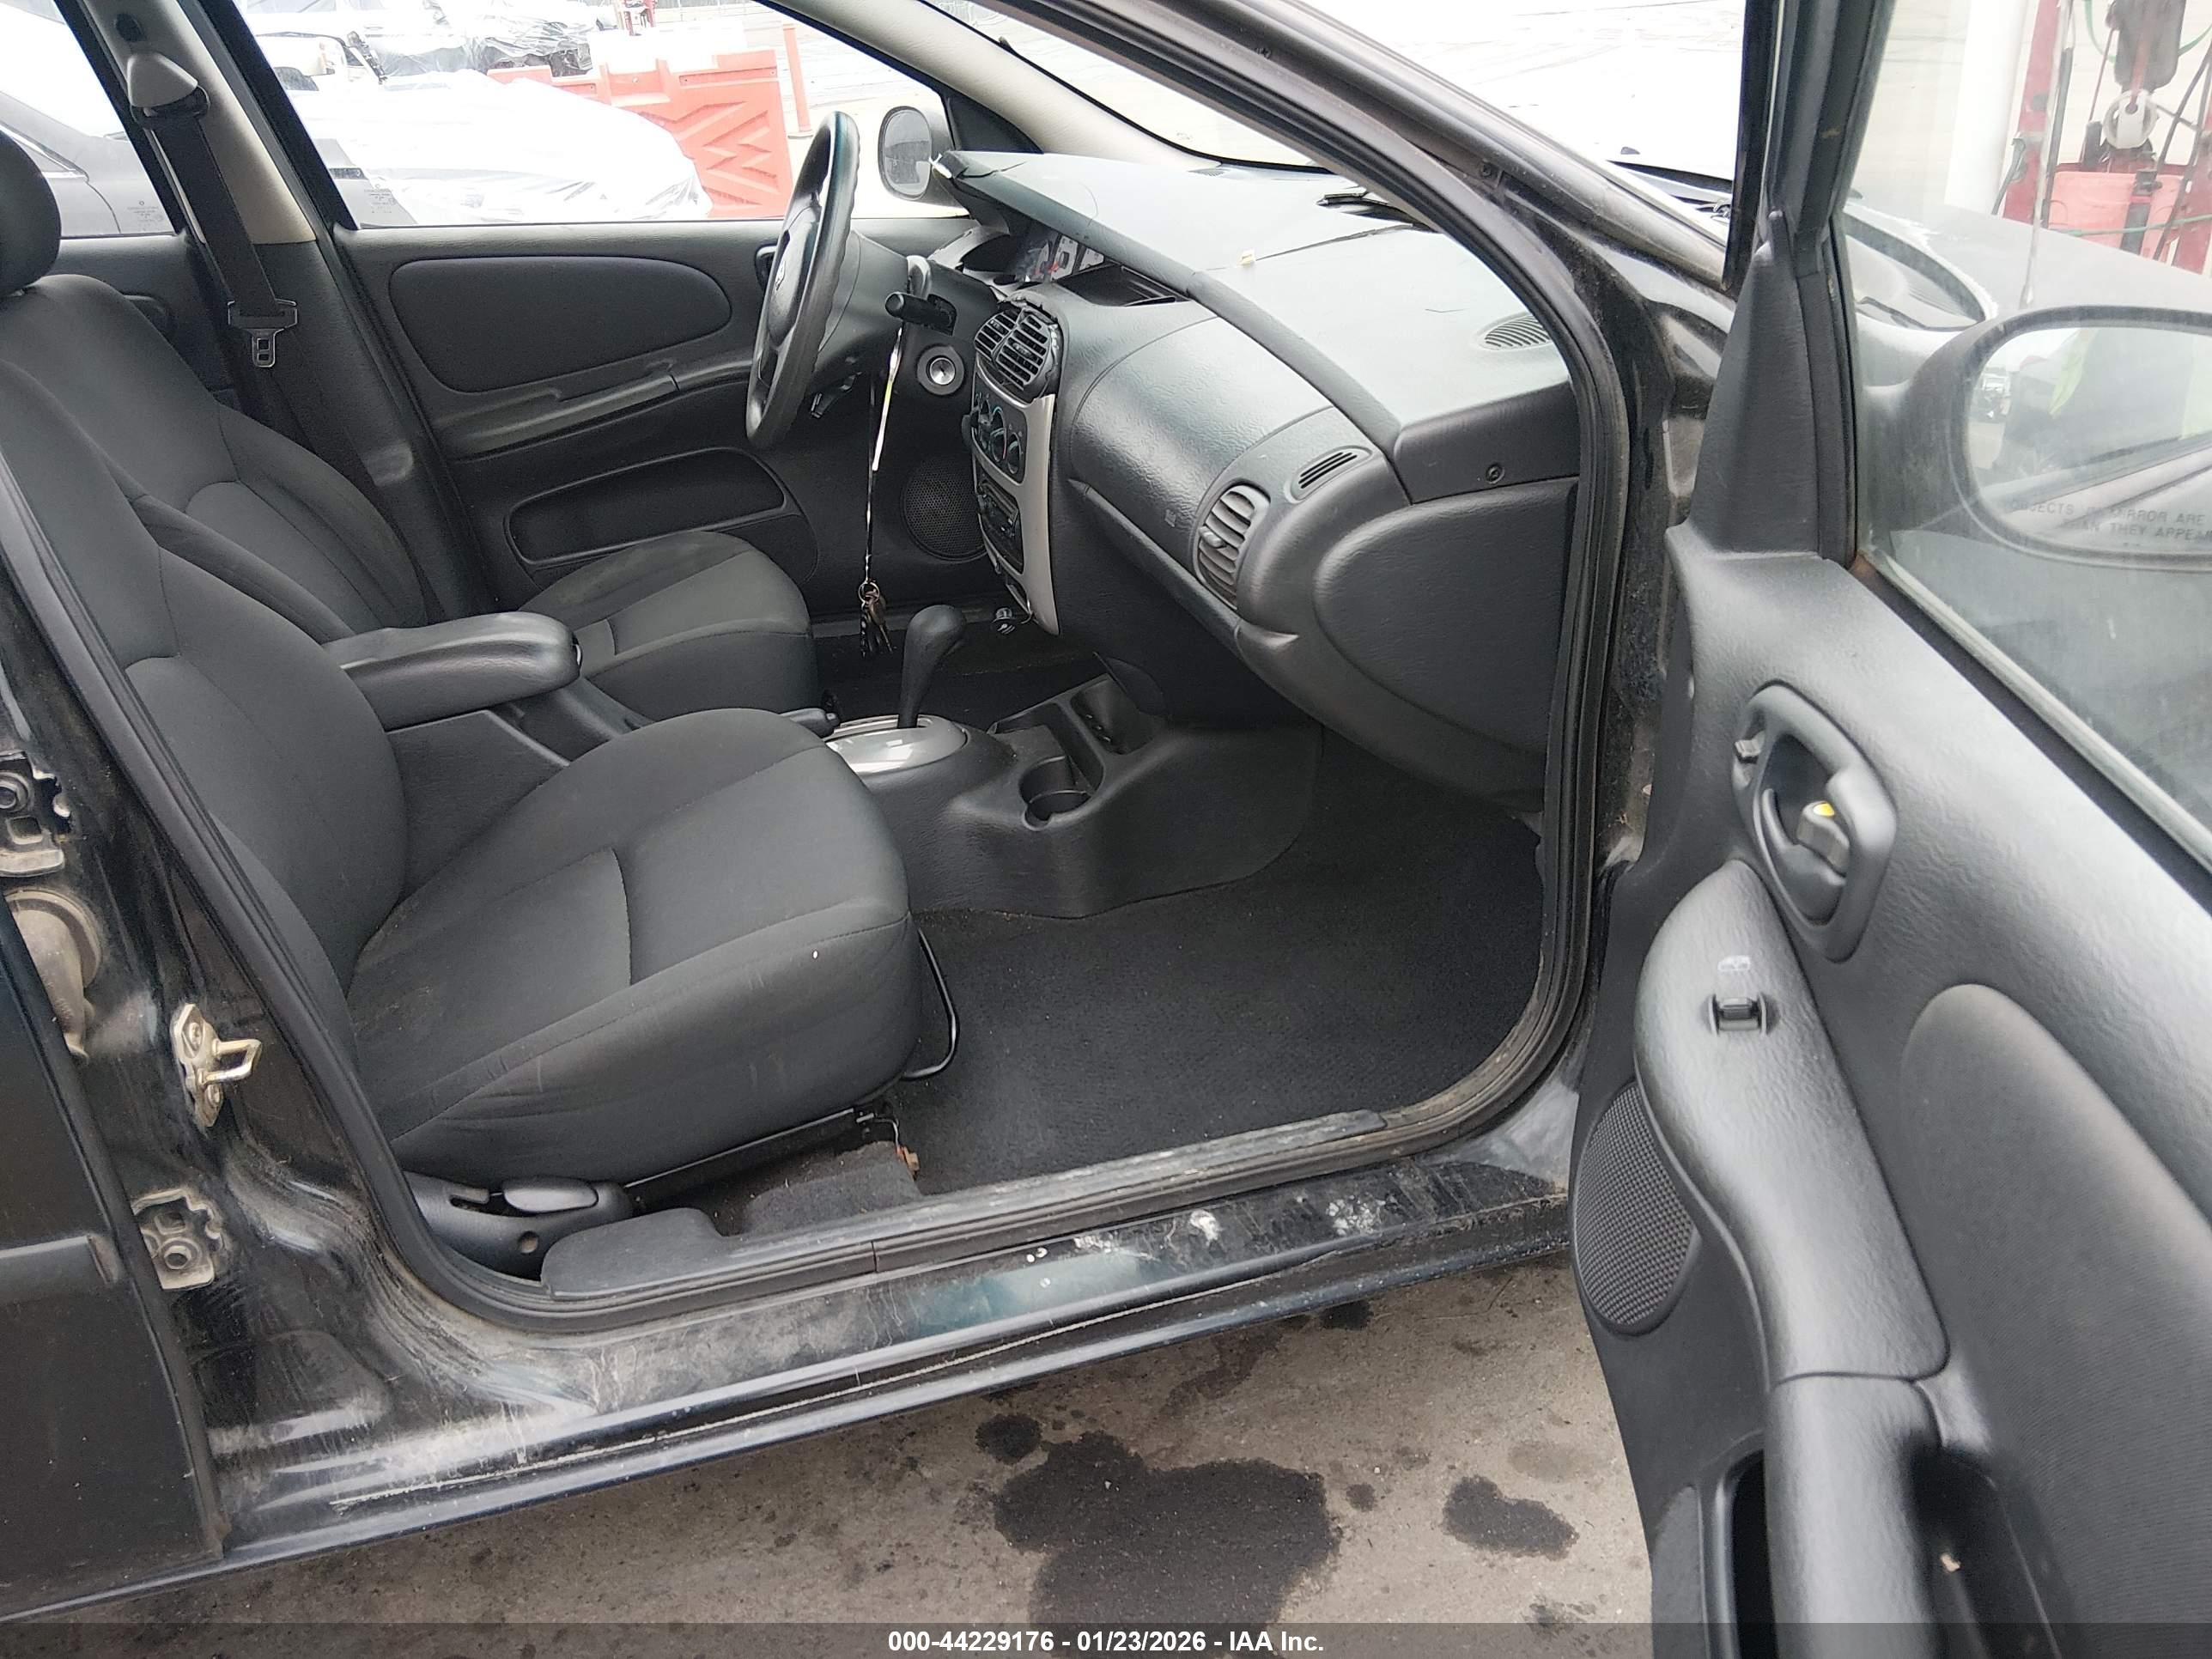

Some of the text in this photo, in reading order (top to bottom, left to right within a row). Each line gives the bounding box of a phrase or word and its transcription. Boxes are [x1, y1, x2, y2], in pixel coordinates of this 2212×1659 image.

[2011, 501, 2075, 516] OBJECTS
[2176, 513, 2206, 526] ARE
[2110, 522, 2148, 535] THEY
